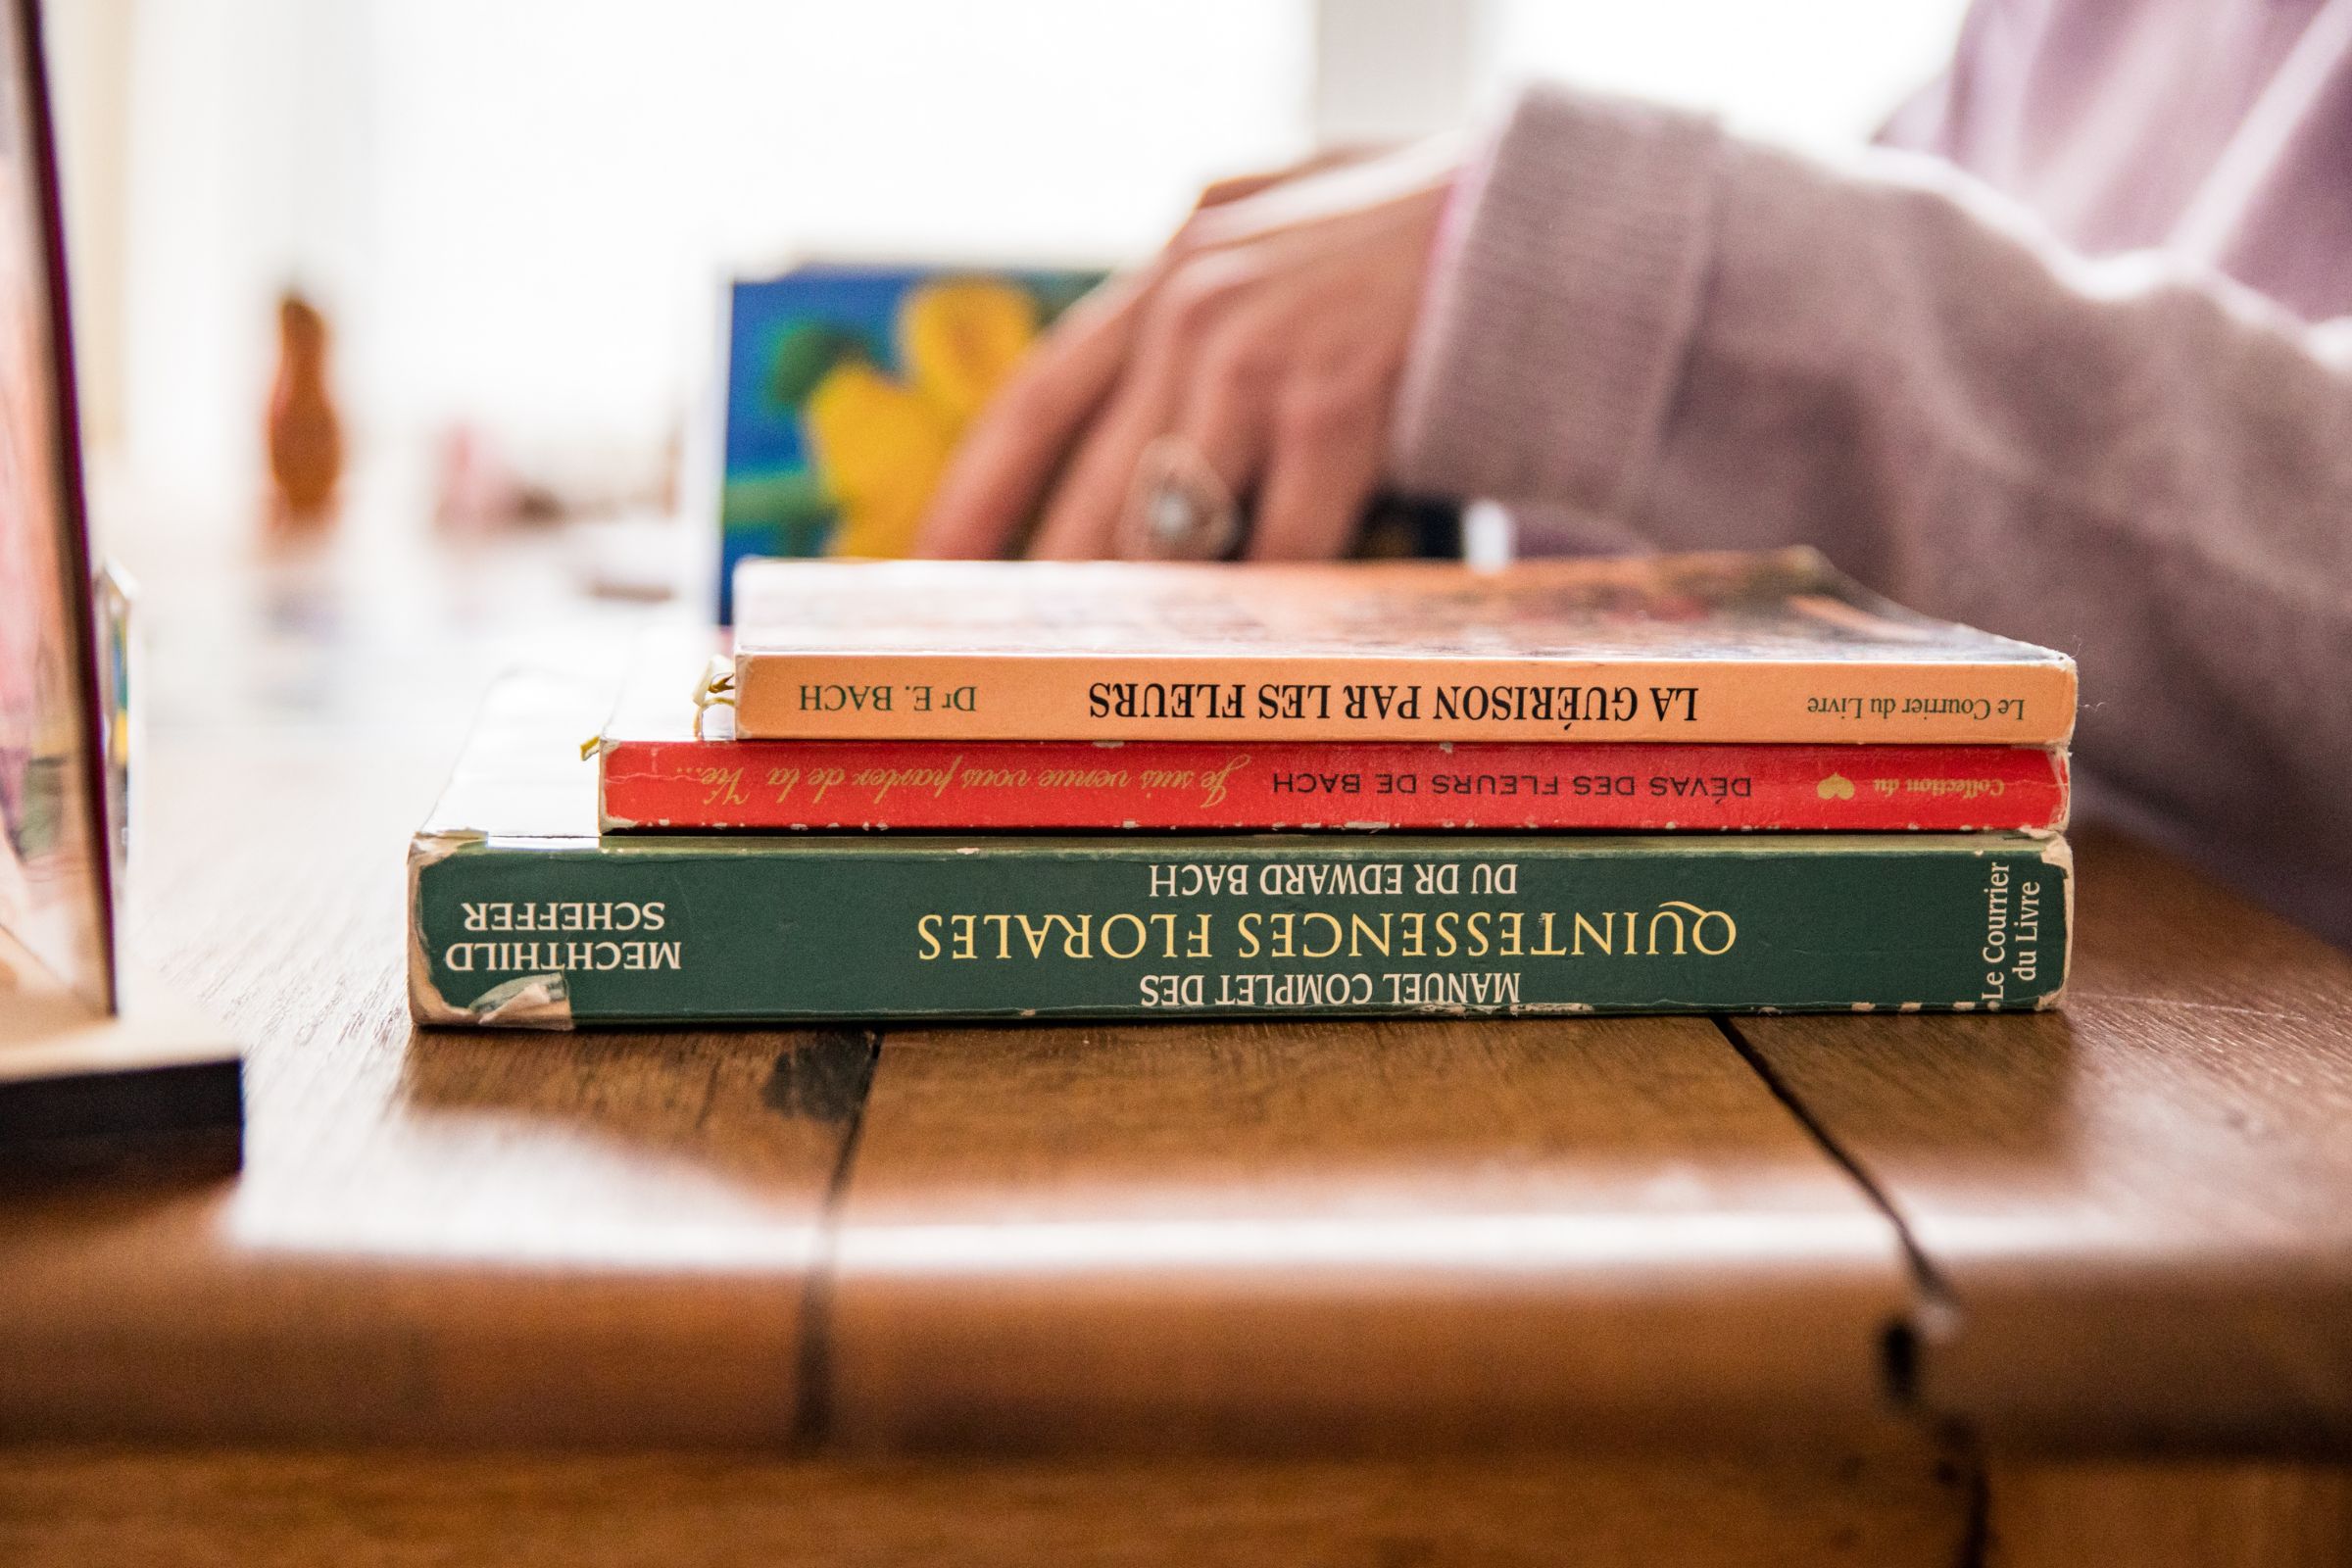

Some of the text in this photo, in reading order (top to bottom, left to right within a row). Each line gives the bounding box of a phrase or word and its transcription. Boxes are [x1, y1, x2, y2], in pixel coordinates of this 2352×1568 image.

[800, 684, 976, 711] Dr E. BACH
[1089, 683, 1698, 731] LA GUÉRISON PAR LES FLEURS
[1807, 698, 2025, 720] Le Courrier du Livre
[765, 767, 801, 804] la
[807, 766, 846, 804] de
[852, 755, 963, 804] parler
[961, 768, 1030, 789] vous
[1039, 769, 1129, 789] venue
[1140, 769, 1195, 798] suis
[1200, 755, 1250, 808] Je
[1272, 772, 1751, 805] DÉVAS DES FLEURS DE BACH
[1872, 778, 2005, 799] Collection du
[1149, 863, 1518, 897] DU DR EDWARD BACH
[462, 902, 665, 931] SCHEFFER
[917, 901, 1737, 960] QUINTESSENCES FLORALES
[1981, 861, 2010, 1001] Le Courrier
[2012, 881, 2040, 981] du Livre
[445, 941, 680, 971] MECHTHILD
[1140, 971, 1521, 1006] MANUEL COMPLET DES
